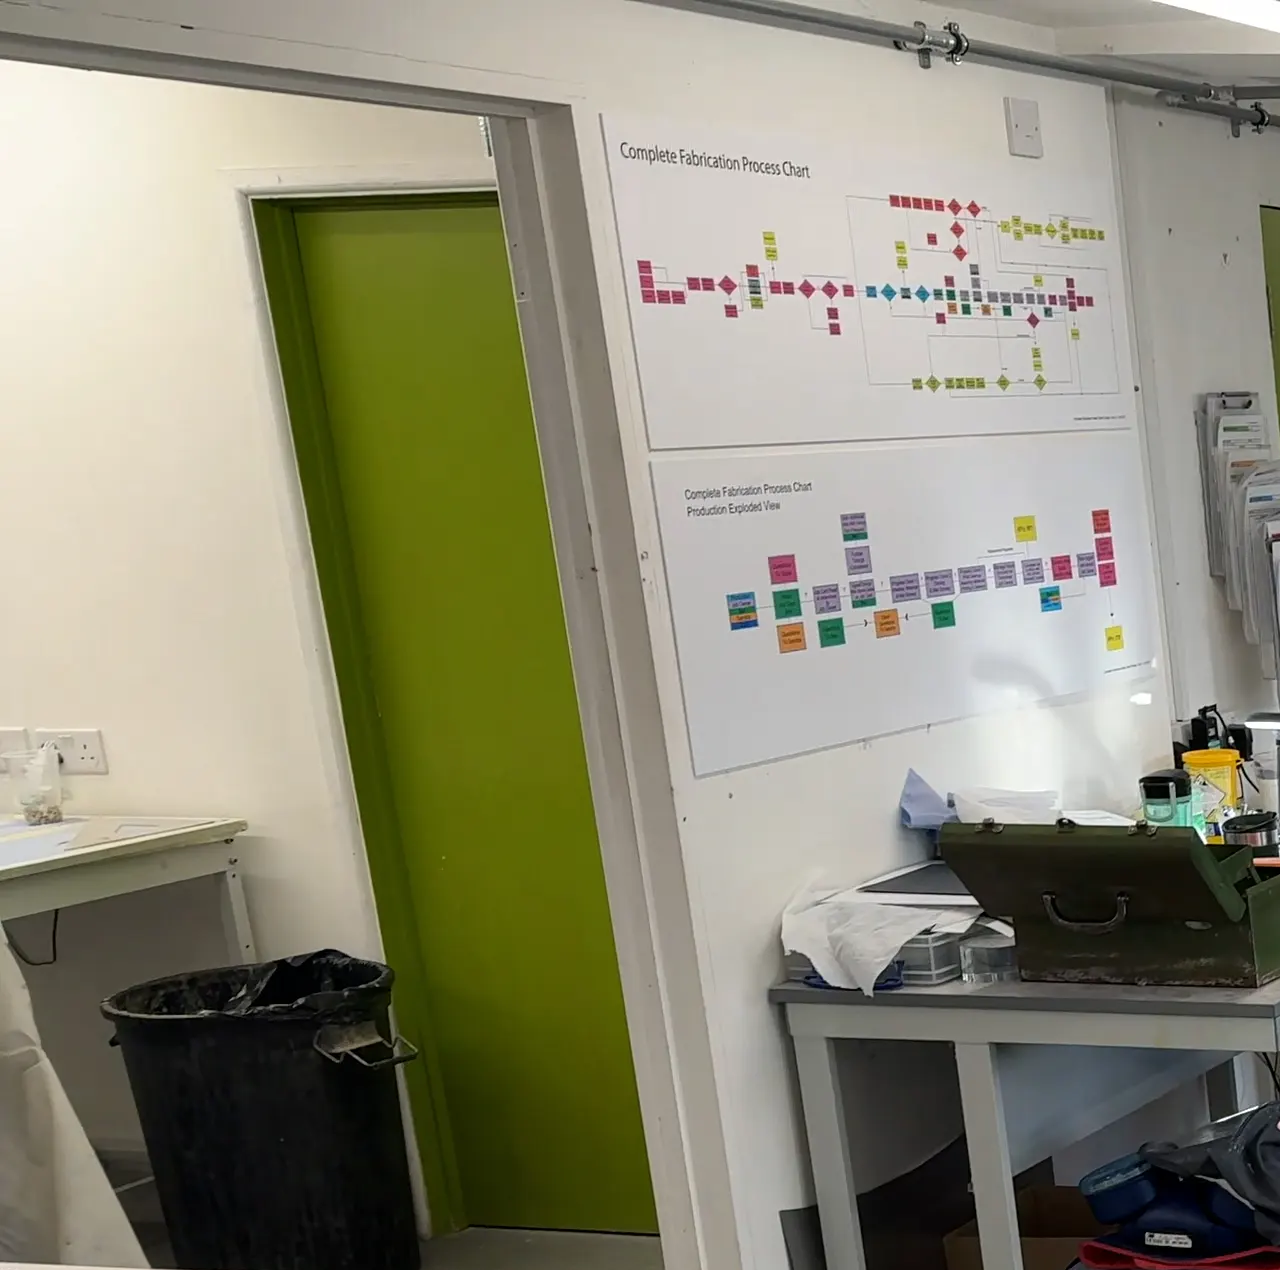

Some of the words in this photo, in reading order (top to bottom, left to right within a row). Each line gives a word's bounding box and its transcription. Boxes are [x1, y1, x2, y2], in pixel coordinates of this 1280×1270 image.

[620, 141, 678, 165] Complete
[679, 149, 741, 172] Fabrication
[742, 156, 782, 176] Process
[782, 160, 811, 179] Chart
[684, 488, 721, 501] Complete
[722, 485, 762, 497] Fabrication
[763, 483, 792, 495] Process
[793, 481, 812, 492] Chart
[687, 504, 727, 517] Production
[728, 502, 763, 515] Exploded
[763, 500, 781, 511] View
